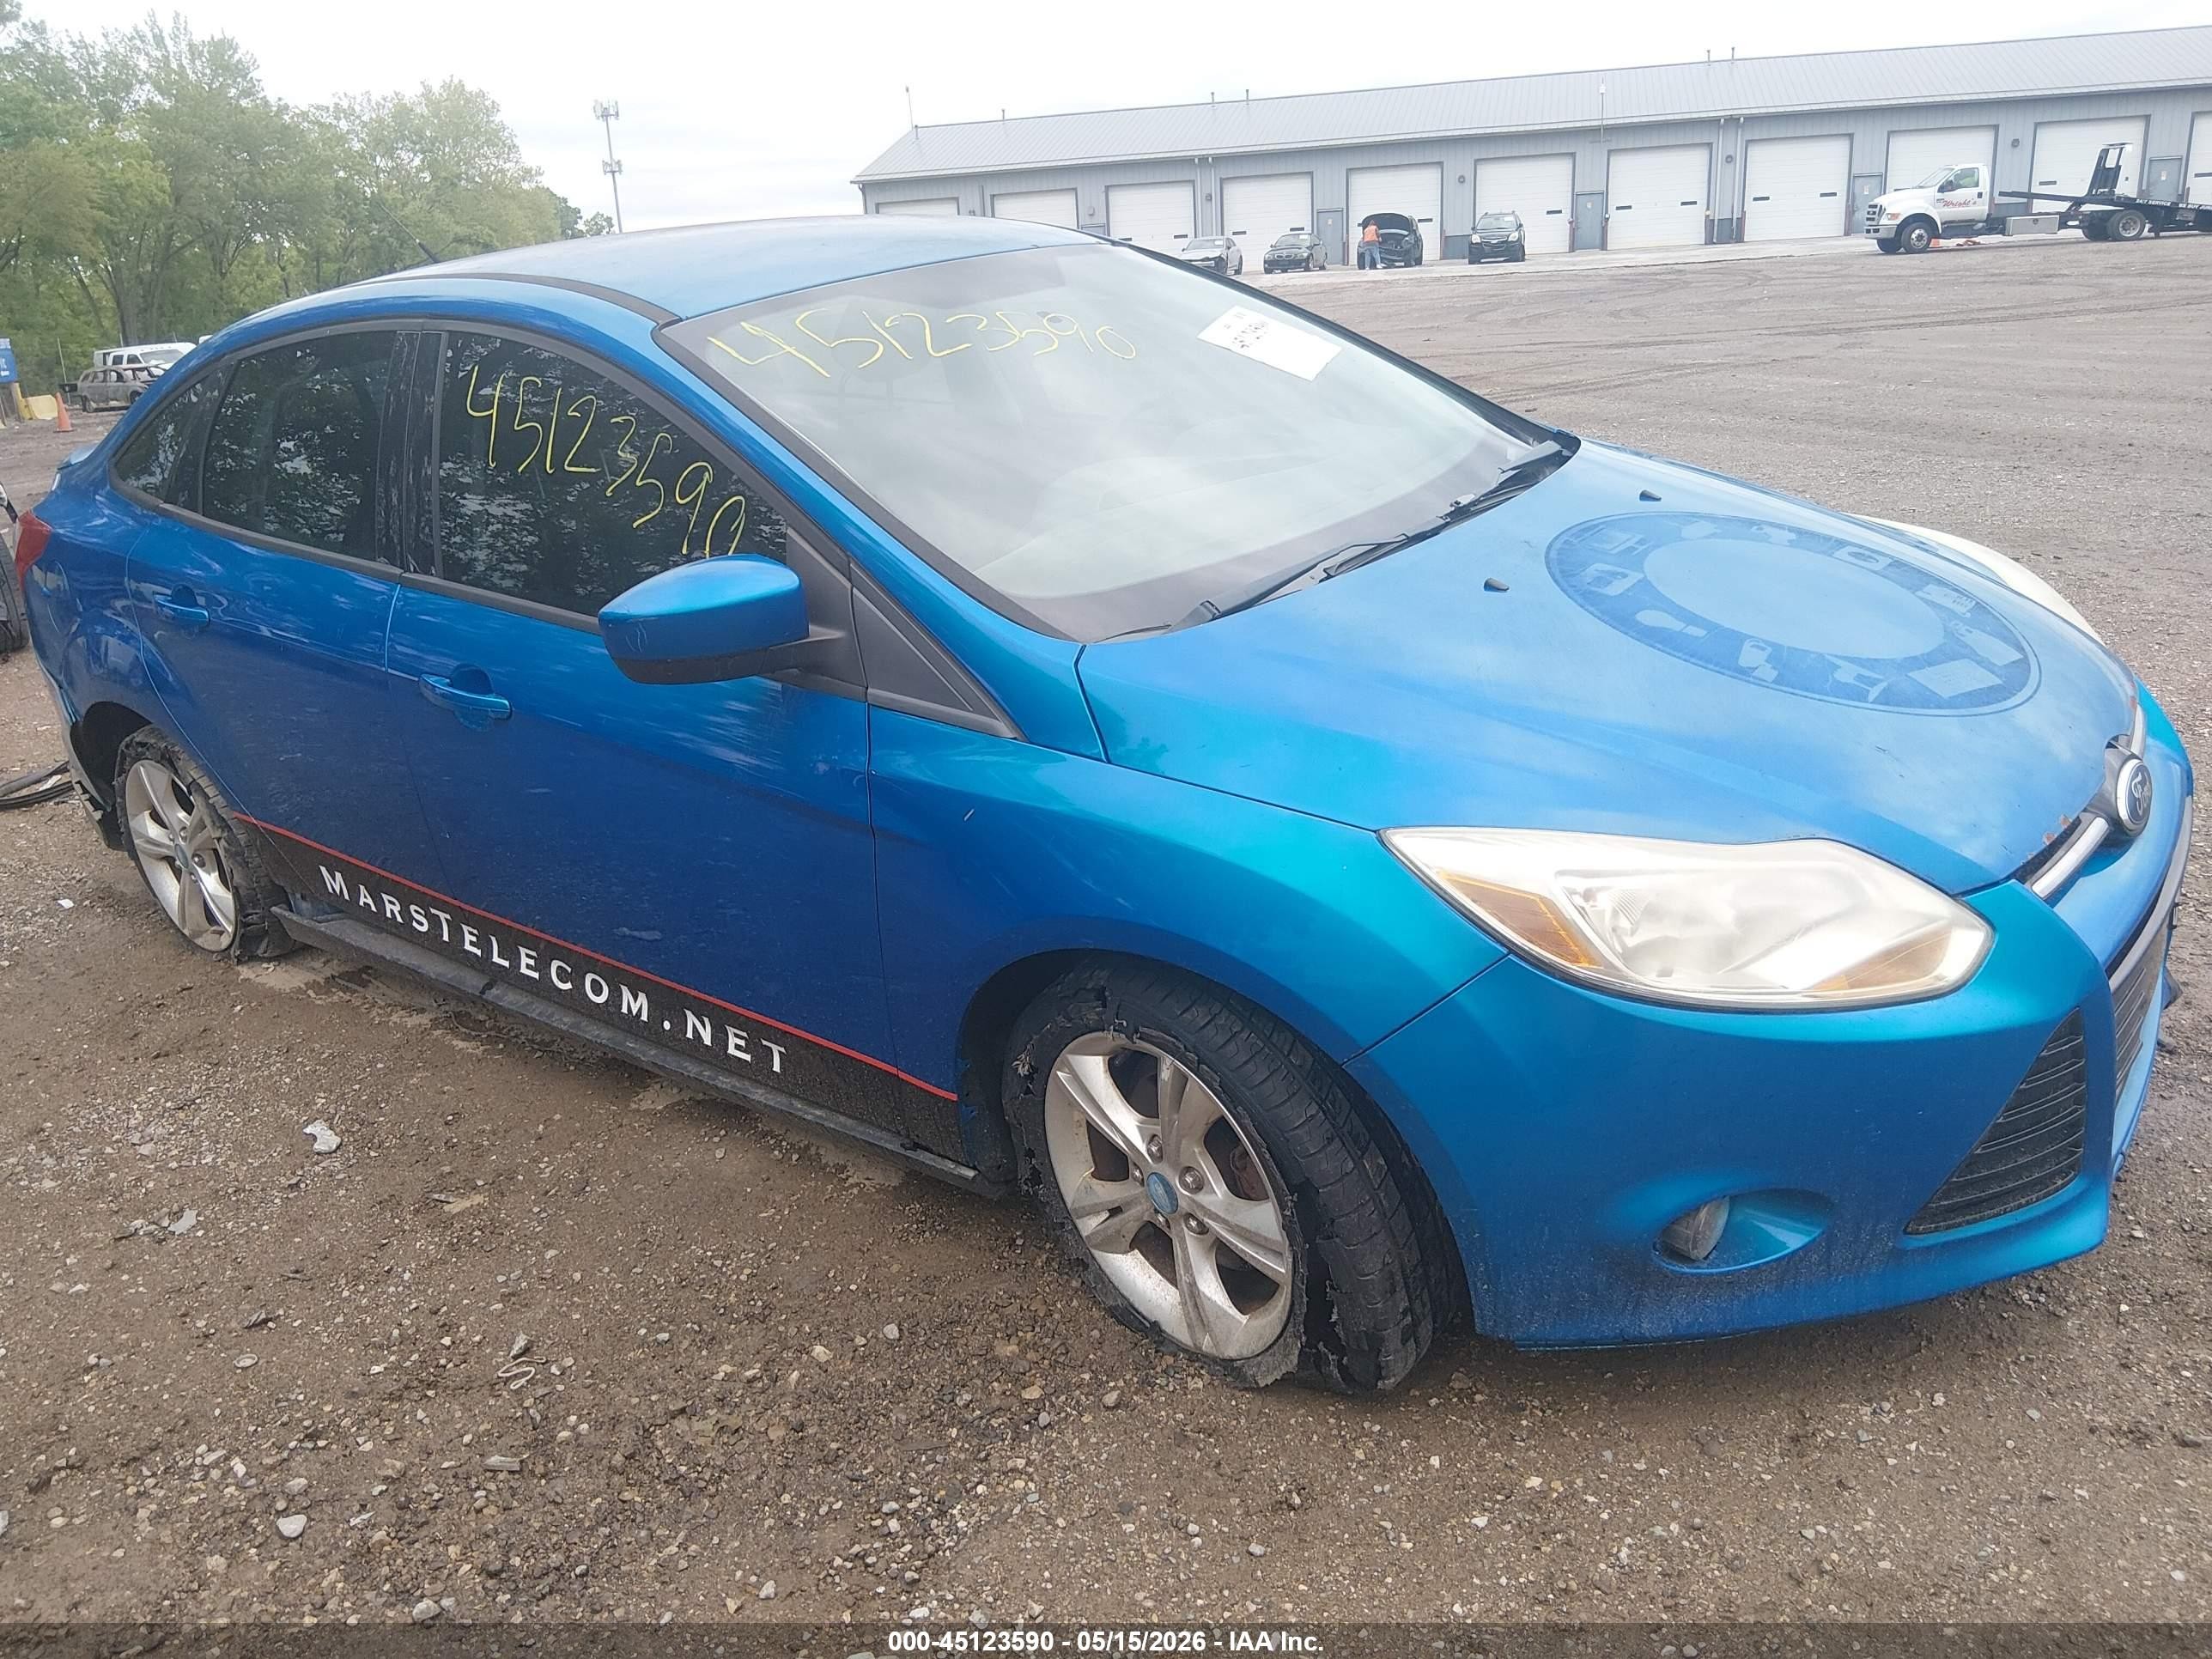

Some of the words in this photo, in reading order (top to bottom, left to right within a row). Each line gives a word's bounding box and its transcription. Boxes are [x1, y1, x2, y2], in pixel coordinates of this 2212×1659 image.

[708, 309, 1137, 378] 45123590
[466, 364, 746, 559] 45123590
[319, 864, 787, 1073] MARSTELECOM.NET
